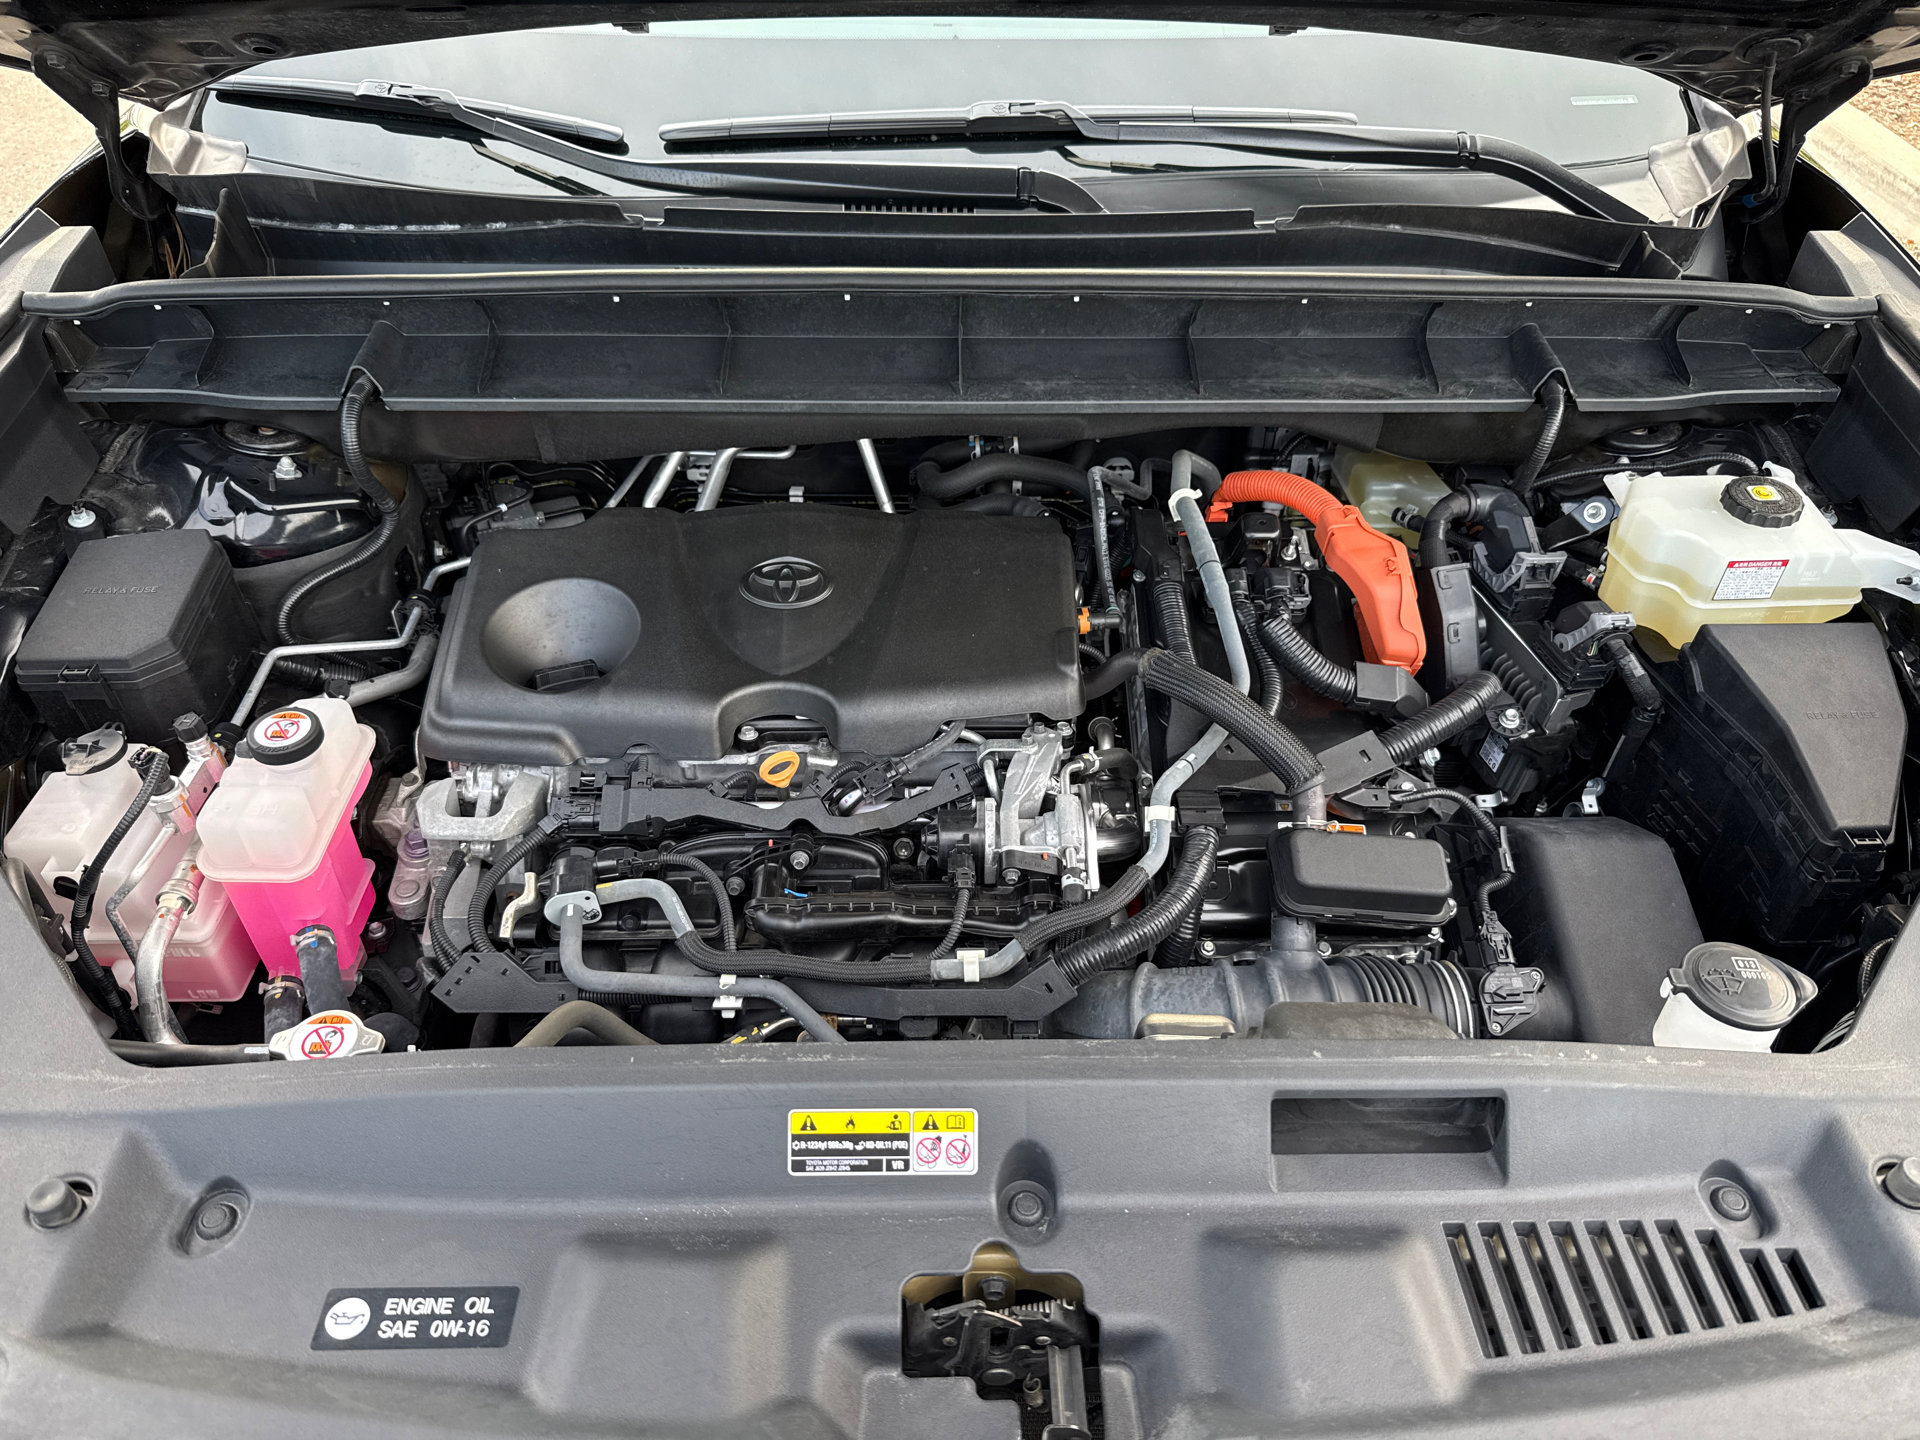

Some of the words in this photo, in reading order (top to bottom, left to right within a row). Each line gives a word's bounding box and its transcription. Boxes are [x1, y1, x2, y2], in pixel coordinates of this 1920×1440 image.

[83, 586, 118, 595] RELAY
[130, 585, 160, 594] FUSE
[1806, 711, 1839, 720] RELAY
[1850, 711, 1879, 720] FUSE
[187, 989, 220, 999] LOW
[891, 1160, 905, 1170] VR
[383, 1296, 456, 1316] ENGINE
[464, 1295, 495, 1315] OIL
[377, 1320, 420, 1338] SAE
[429, 1319, 491, 1338] 0W-16
